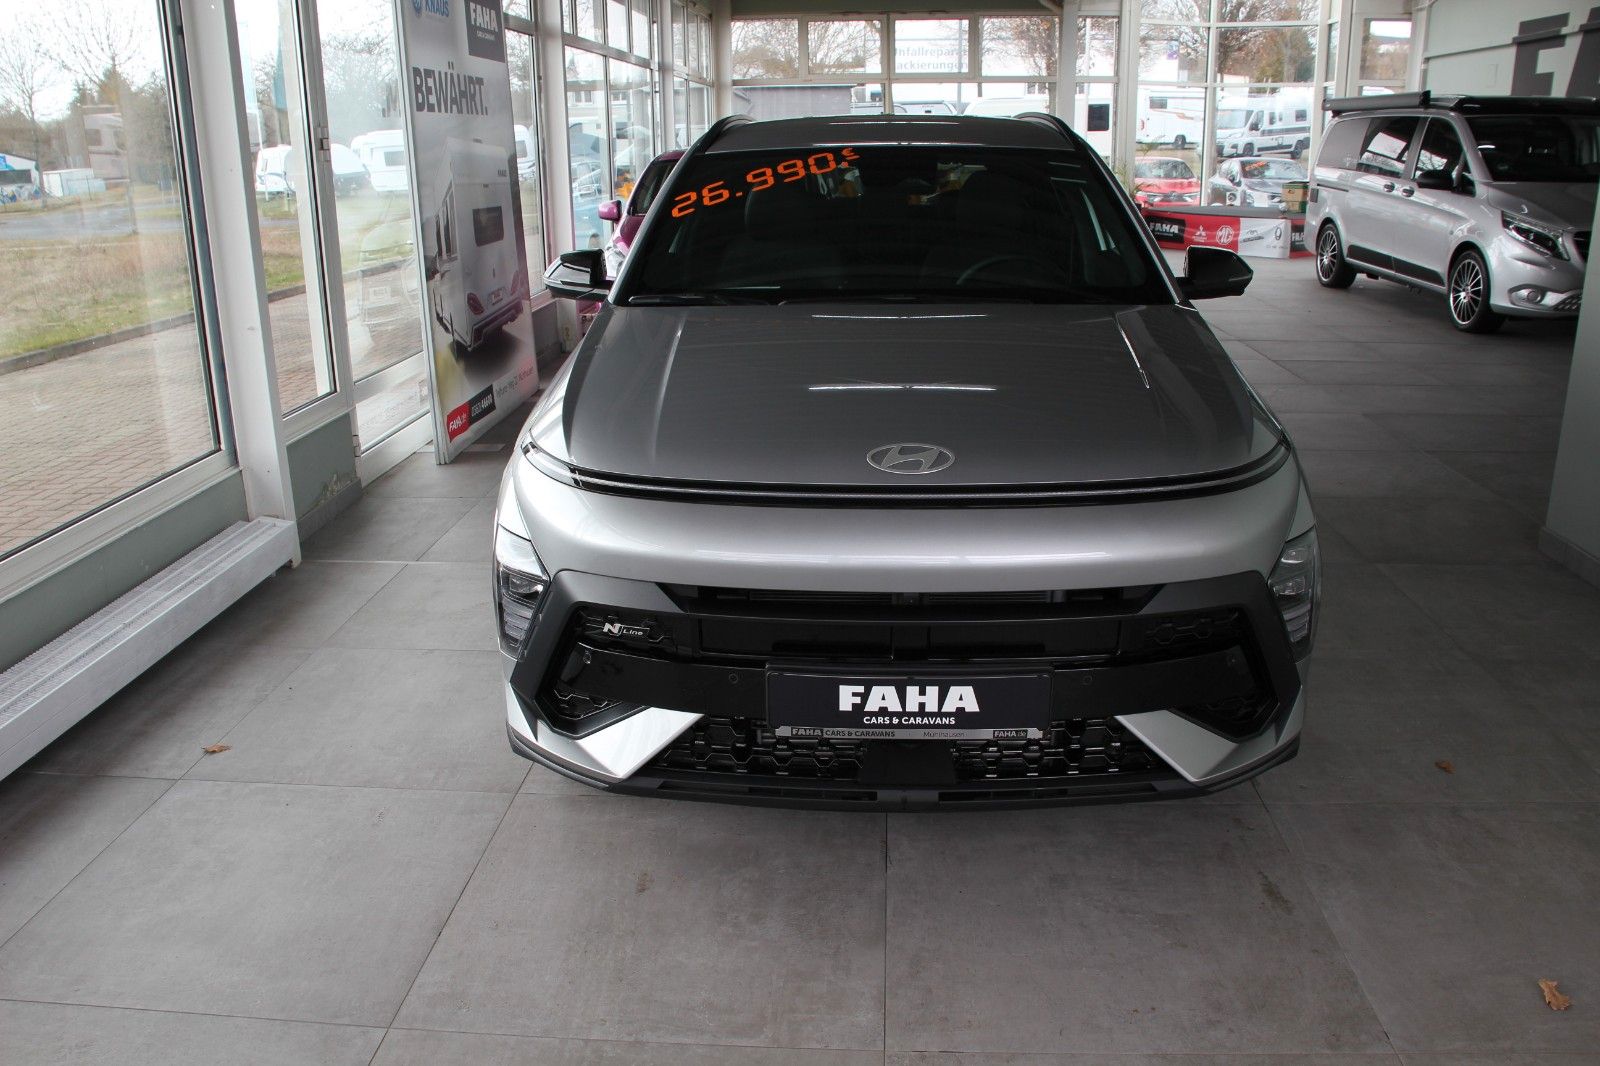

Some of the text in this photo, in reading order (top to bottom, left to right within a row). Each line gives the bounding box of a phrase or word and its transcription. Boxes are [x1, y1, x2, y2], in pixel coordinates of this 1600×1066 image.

[470, 2, 499, 32] FAHA
[412, 61, 488, 116] BEWÄHRT.
[839, 685, 980, 712] FAHA
[792, 728, 821, 737] FAHA
[825, 729, 846, 737] CARS
[854, 729, 896, 738] CARAVANS
[863, 716, 956, 725] CARS & CARAVANS
